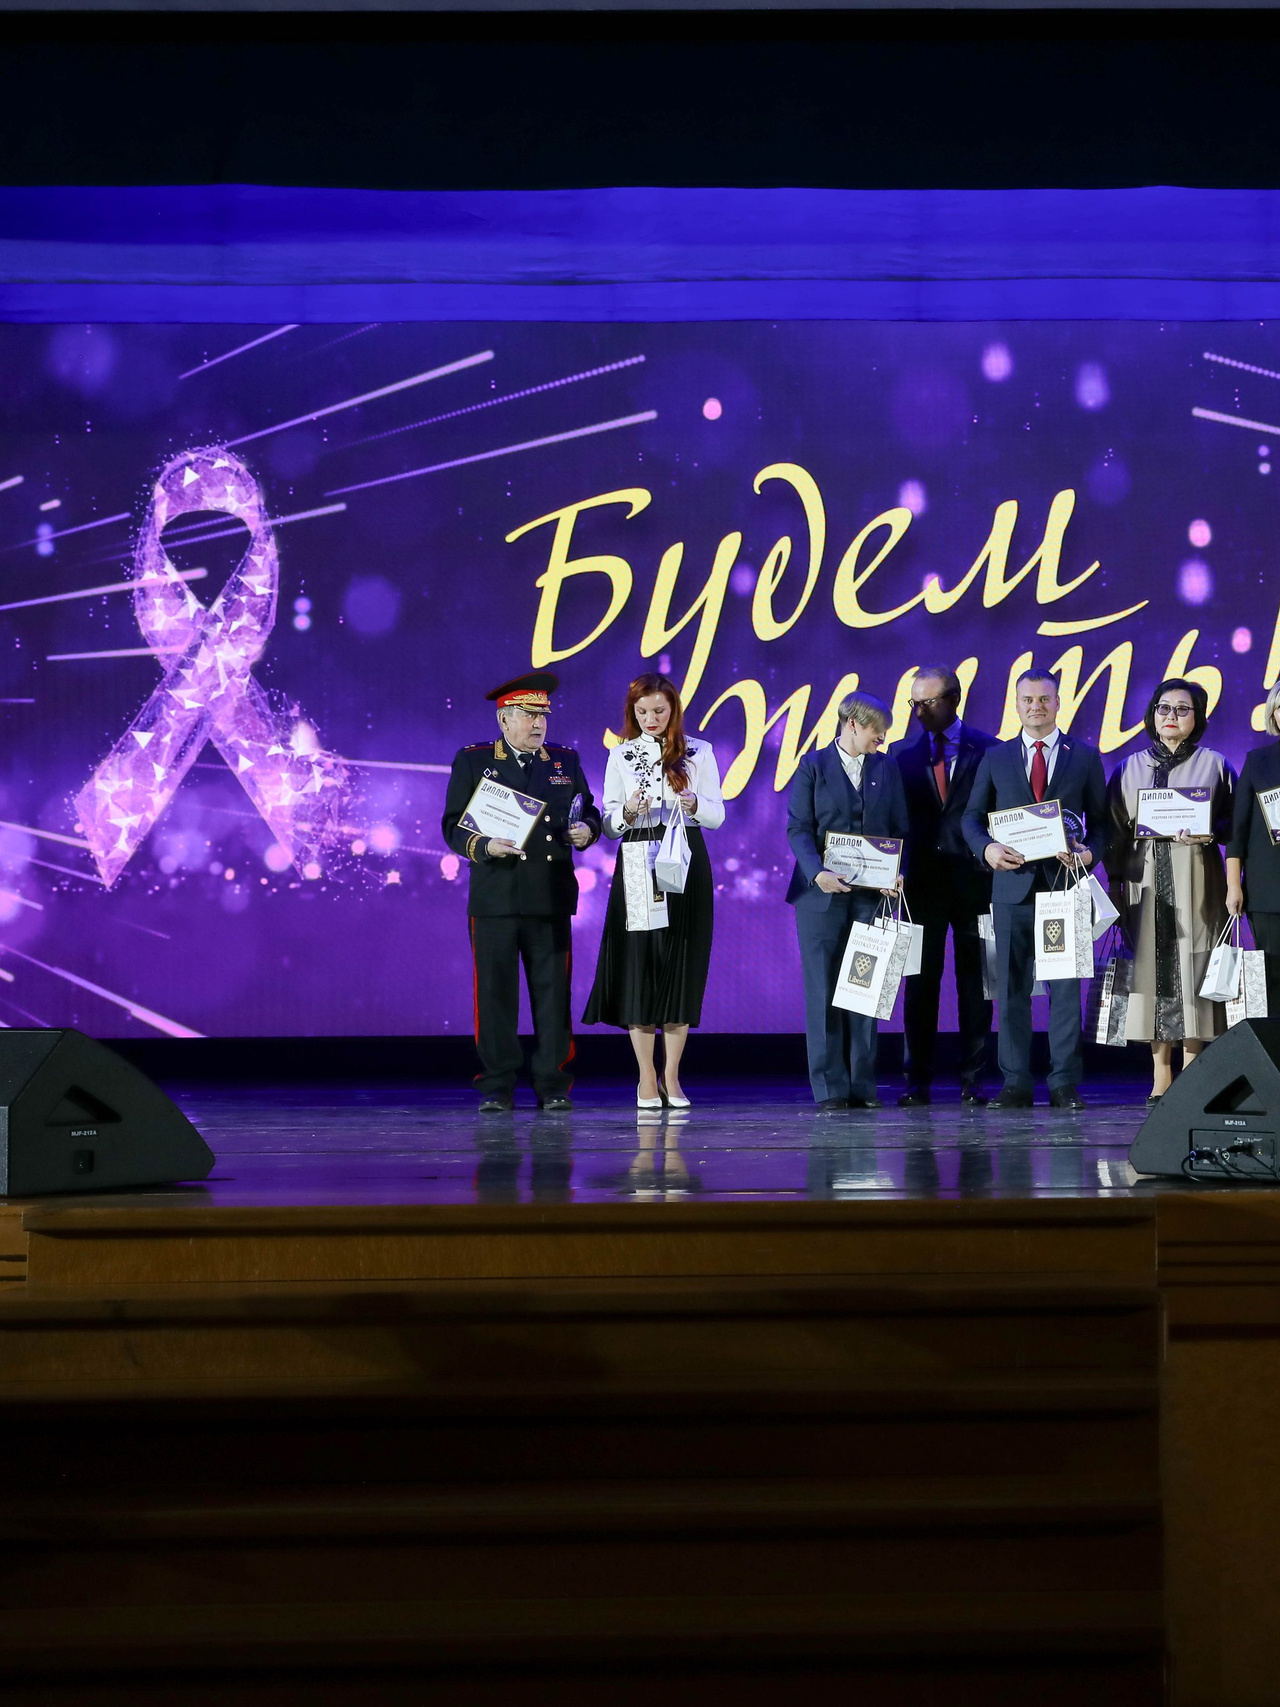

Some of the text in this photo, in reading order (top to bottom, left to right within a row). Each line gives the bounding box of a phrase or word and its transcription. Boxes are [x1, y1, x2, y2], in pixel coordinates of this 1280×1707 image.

[504, 462, 1101, 748] Будем
[480, 782, 510, 801] ДИПЛОМ
[1141, 792, 1173, 801] ДИПЛОМ
[993, 811, 1025, 827] ДИПЛОМ
[829, 836, 863, 847] ДИПЛОМ
[1044, 943, 1065, 952] Libertad
[848, 974, 871, 987] Libertad
